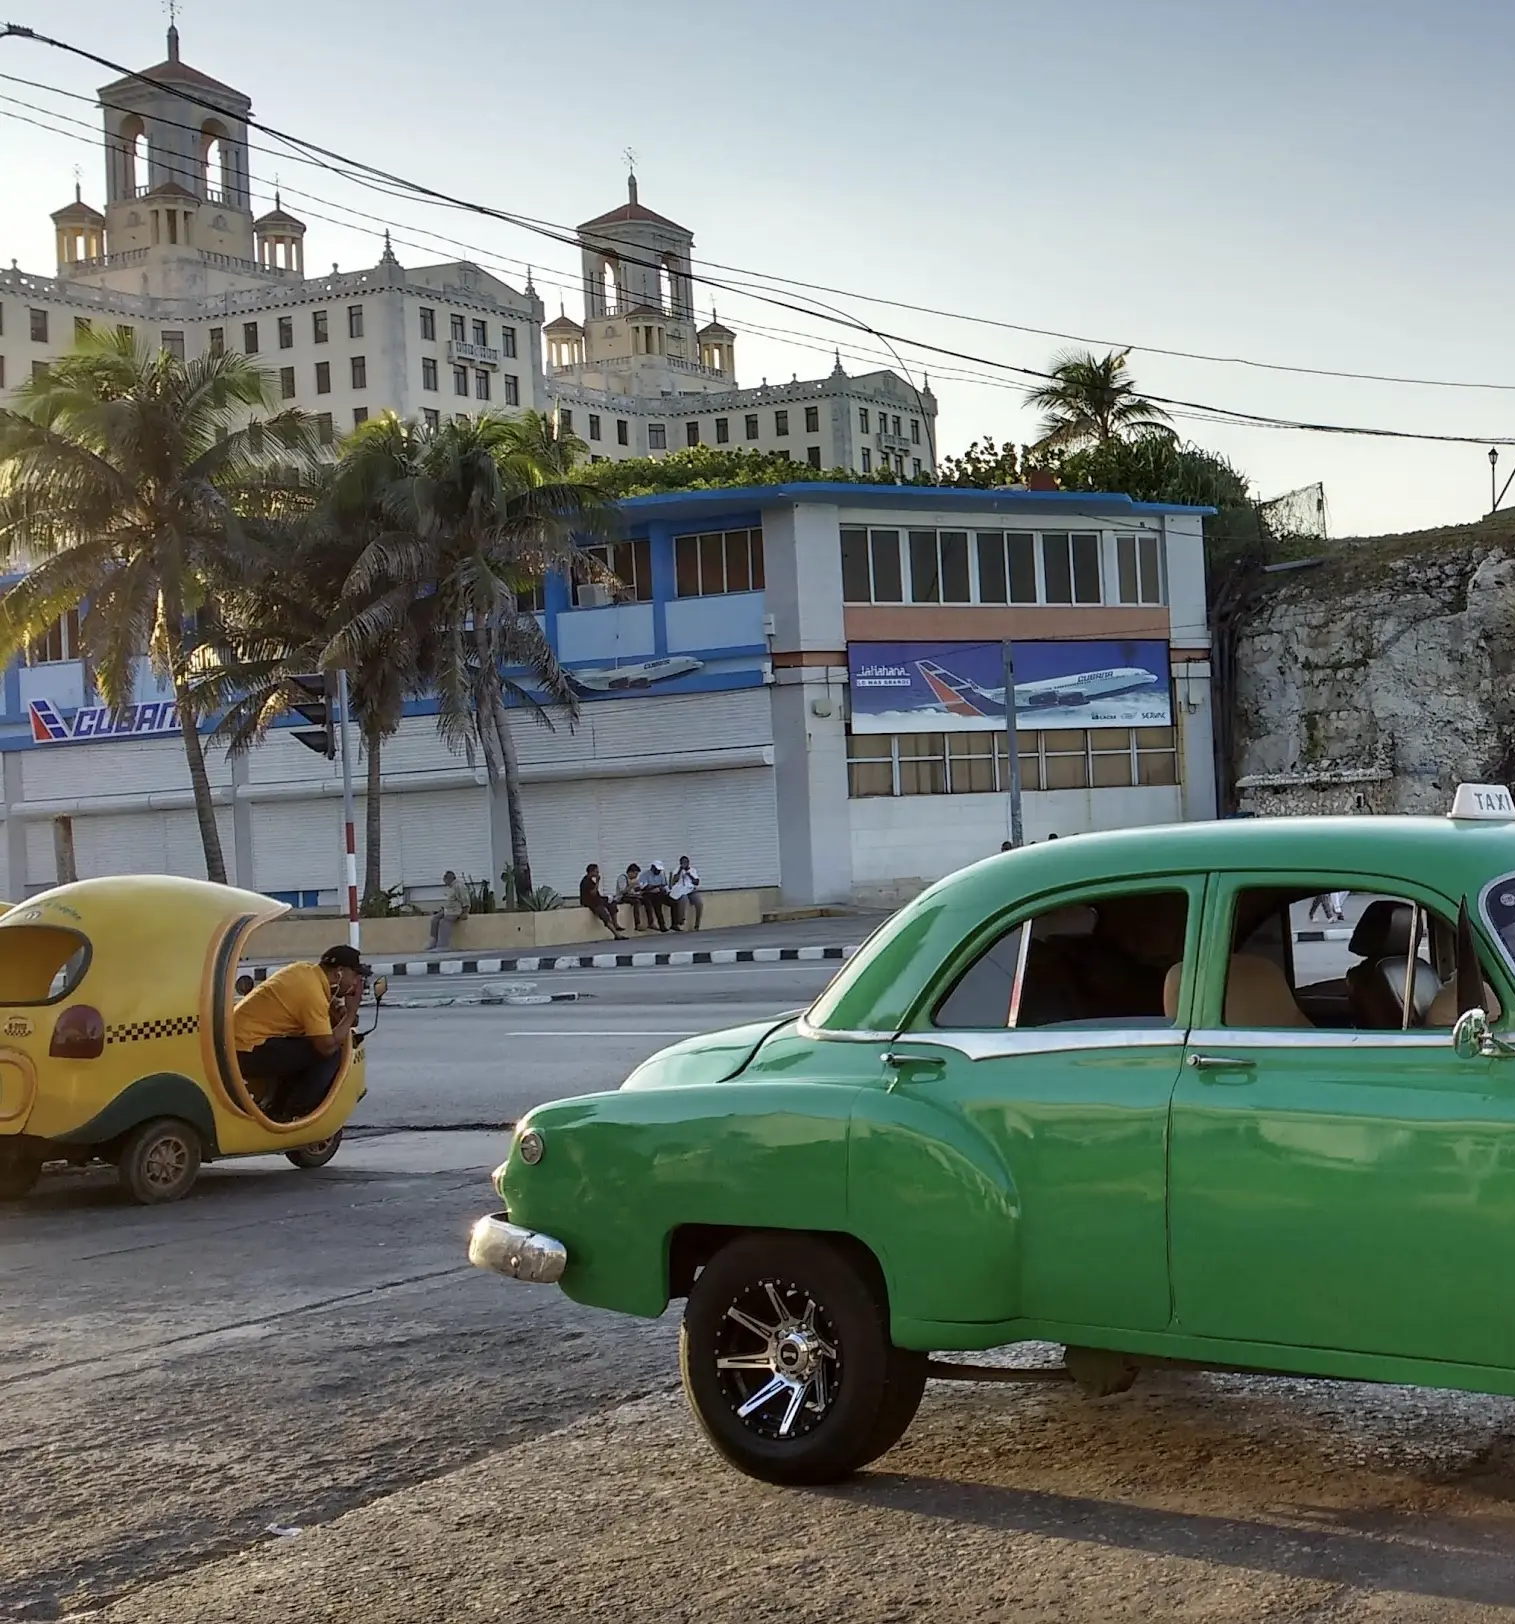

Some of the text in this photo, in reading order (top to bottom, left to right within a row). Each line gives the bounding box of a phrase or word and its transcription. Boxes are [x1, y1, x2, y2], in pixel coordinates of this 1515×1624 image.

[1078, 671, 1114, 683] CUBANA
[73, 702, 199, 737] CUBAN
[1474, 792, 1511, 811] TAXI
